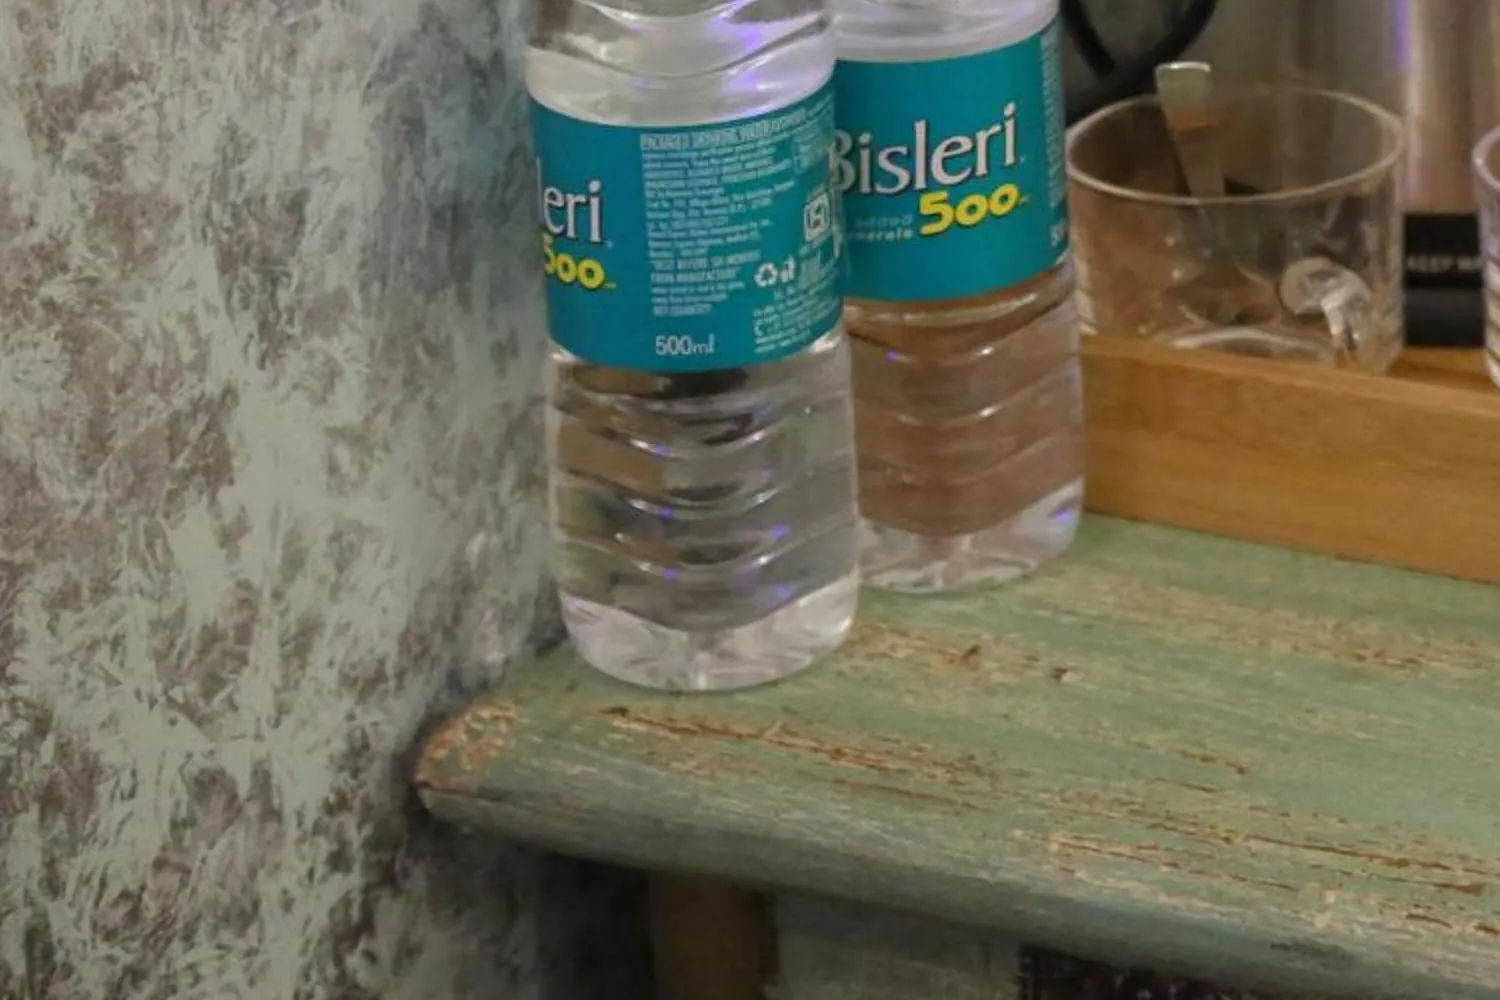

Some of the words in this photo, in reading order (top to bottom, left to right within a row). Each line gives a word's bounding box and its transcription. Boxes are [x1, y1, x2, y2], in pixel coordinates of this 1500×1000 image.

[829, 102, 1016, 194] Bisleri
[919, 183, 1020, 236] 500
[655, 333, 715, 356] 500ml
